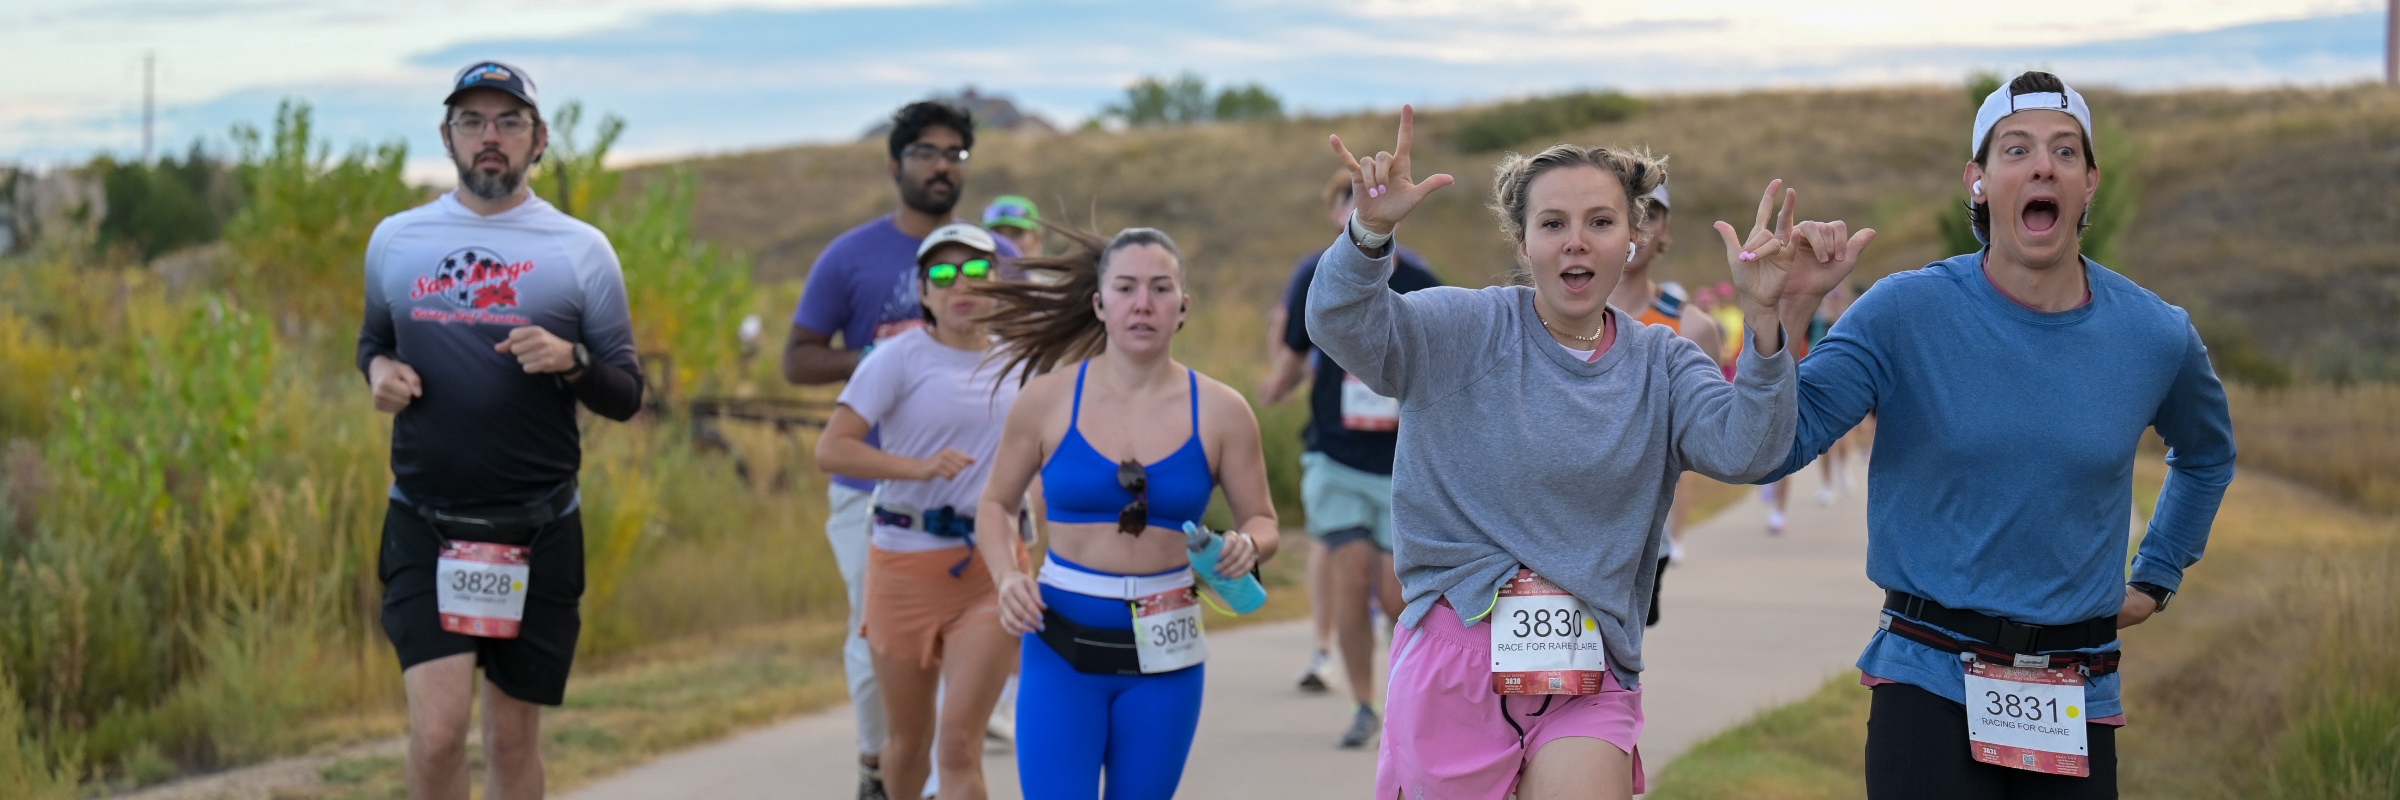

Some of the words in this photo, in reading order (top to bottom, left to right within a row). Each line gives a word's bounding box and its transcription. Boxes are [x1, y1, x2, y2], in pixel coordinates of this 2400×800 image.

[410, 275, 455, 300] San
[462, 259, 536, 286] Diego
[451, 568, 512, 596] 3828
[1151, 616, 1198, 647] 3678
[1512, 608, 1582, 638] 3830
[1497, 643, 1524, 652] RACE
[1526, 642, 1546, 651] FOR
[1548, 642, 1572, 651] RARE
[1985, 690, 2058, 724] 3831
[1981, 717, 2016, 729] RACING
[2018, 722, 2036, 732] FOR
[2038, 725, 2070, 736] CLAIRE
